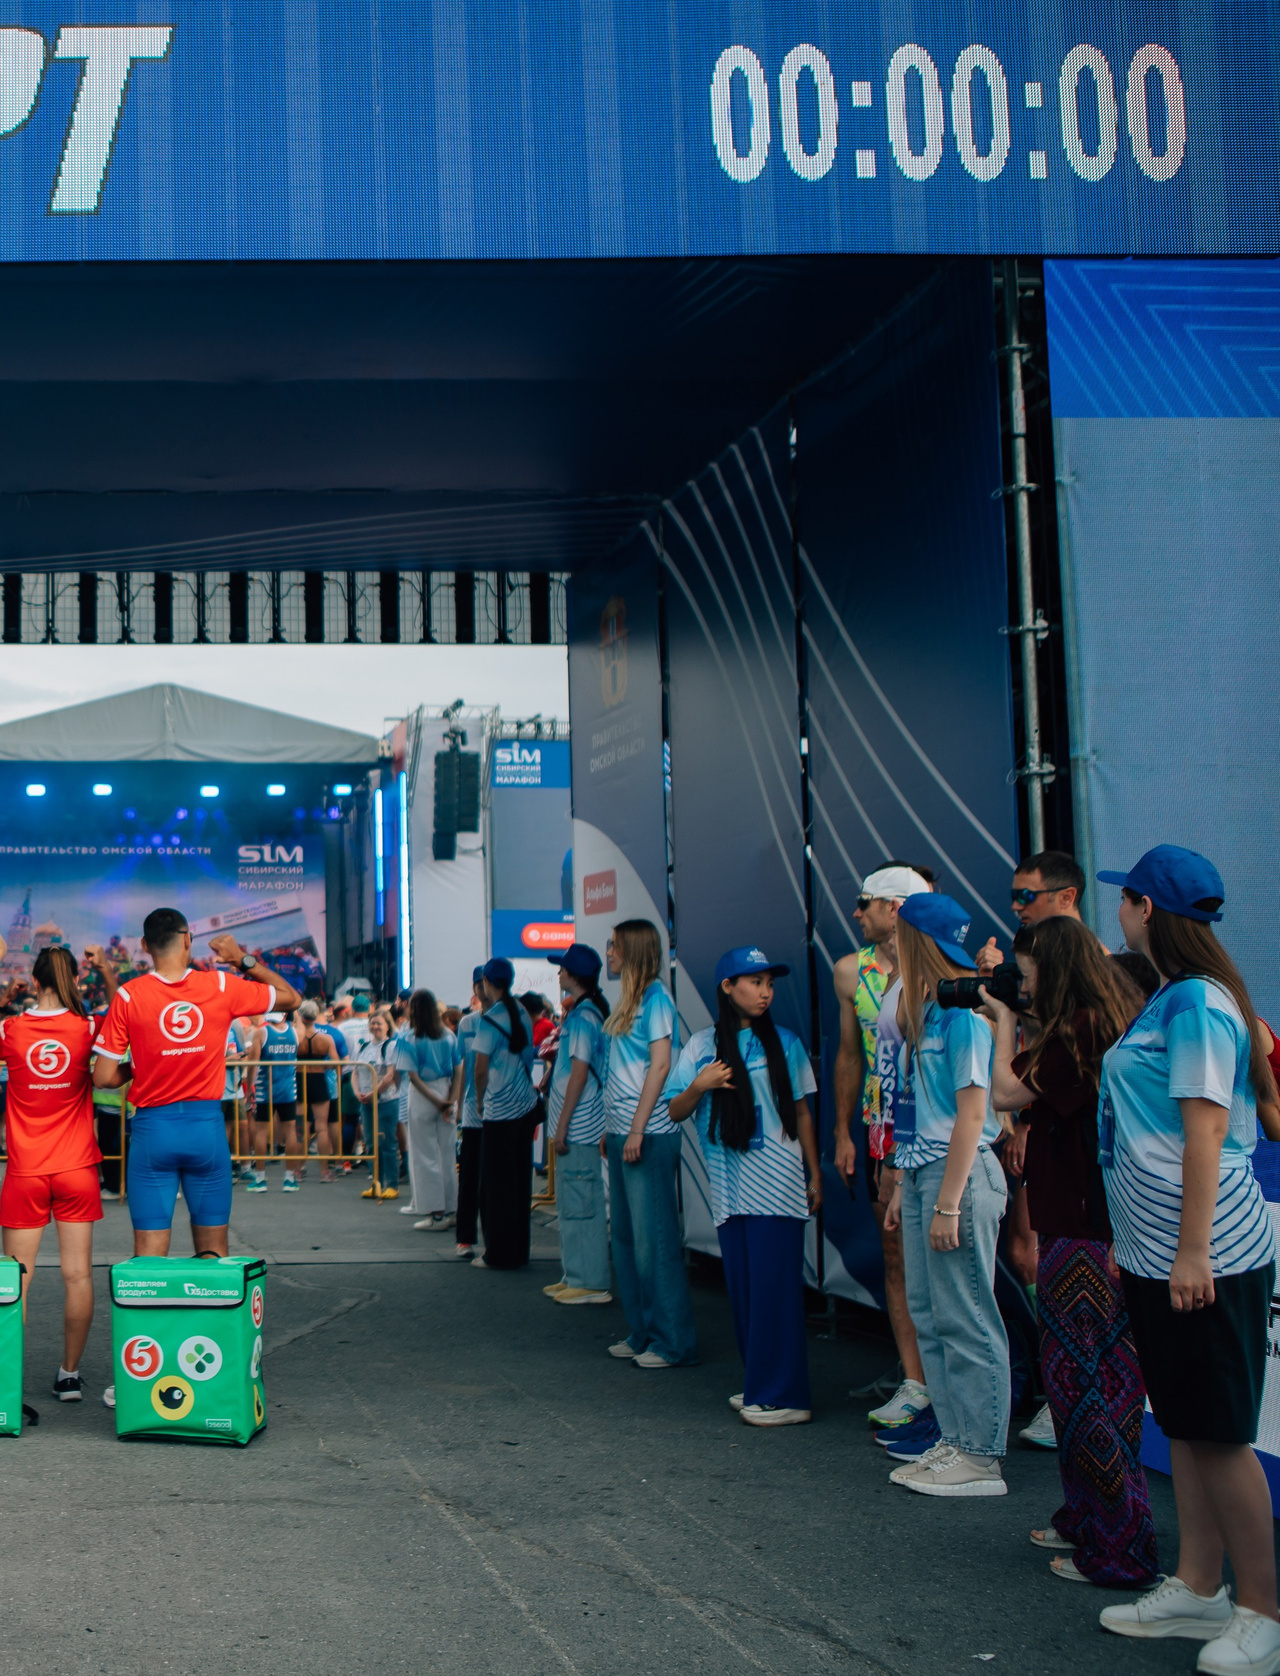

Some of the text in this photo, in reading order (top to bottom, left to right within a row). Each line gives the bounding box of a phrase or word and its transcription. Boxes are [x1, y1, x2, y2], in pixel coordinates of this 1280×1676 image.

[710, 43, 1187, 183] 00:00:00
[496, 776, 541, 784] МАРАФОН
[101, 845, 152, 855] ОМСКОЙ
[157, 846, 211, 855] ОБЛАСТИ
[238, 865, 303, 874] СИБИРСКИЙ
[238, 881, 303, 890] МАРАФОН
[117, 1279, 167, 1288] Доставляем
[118, 1289, 157, 1297] продукты
